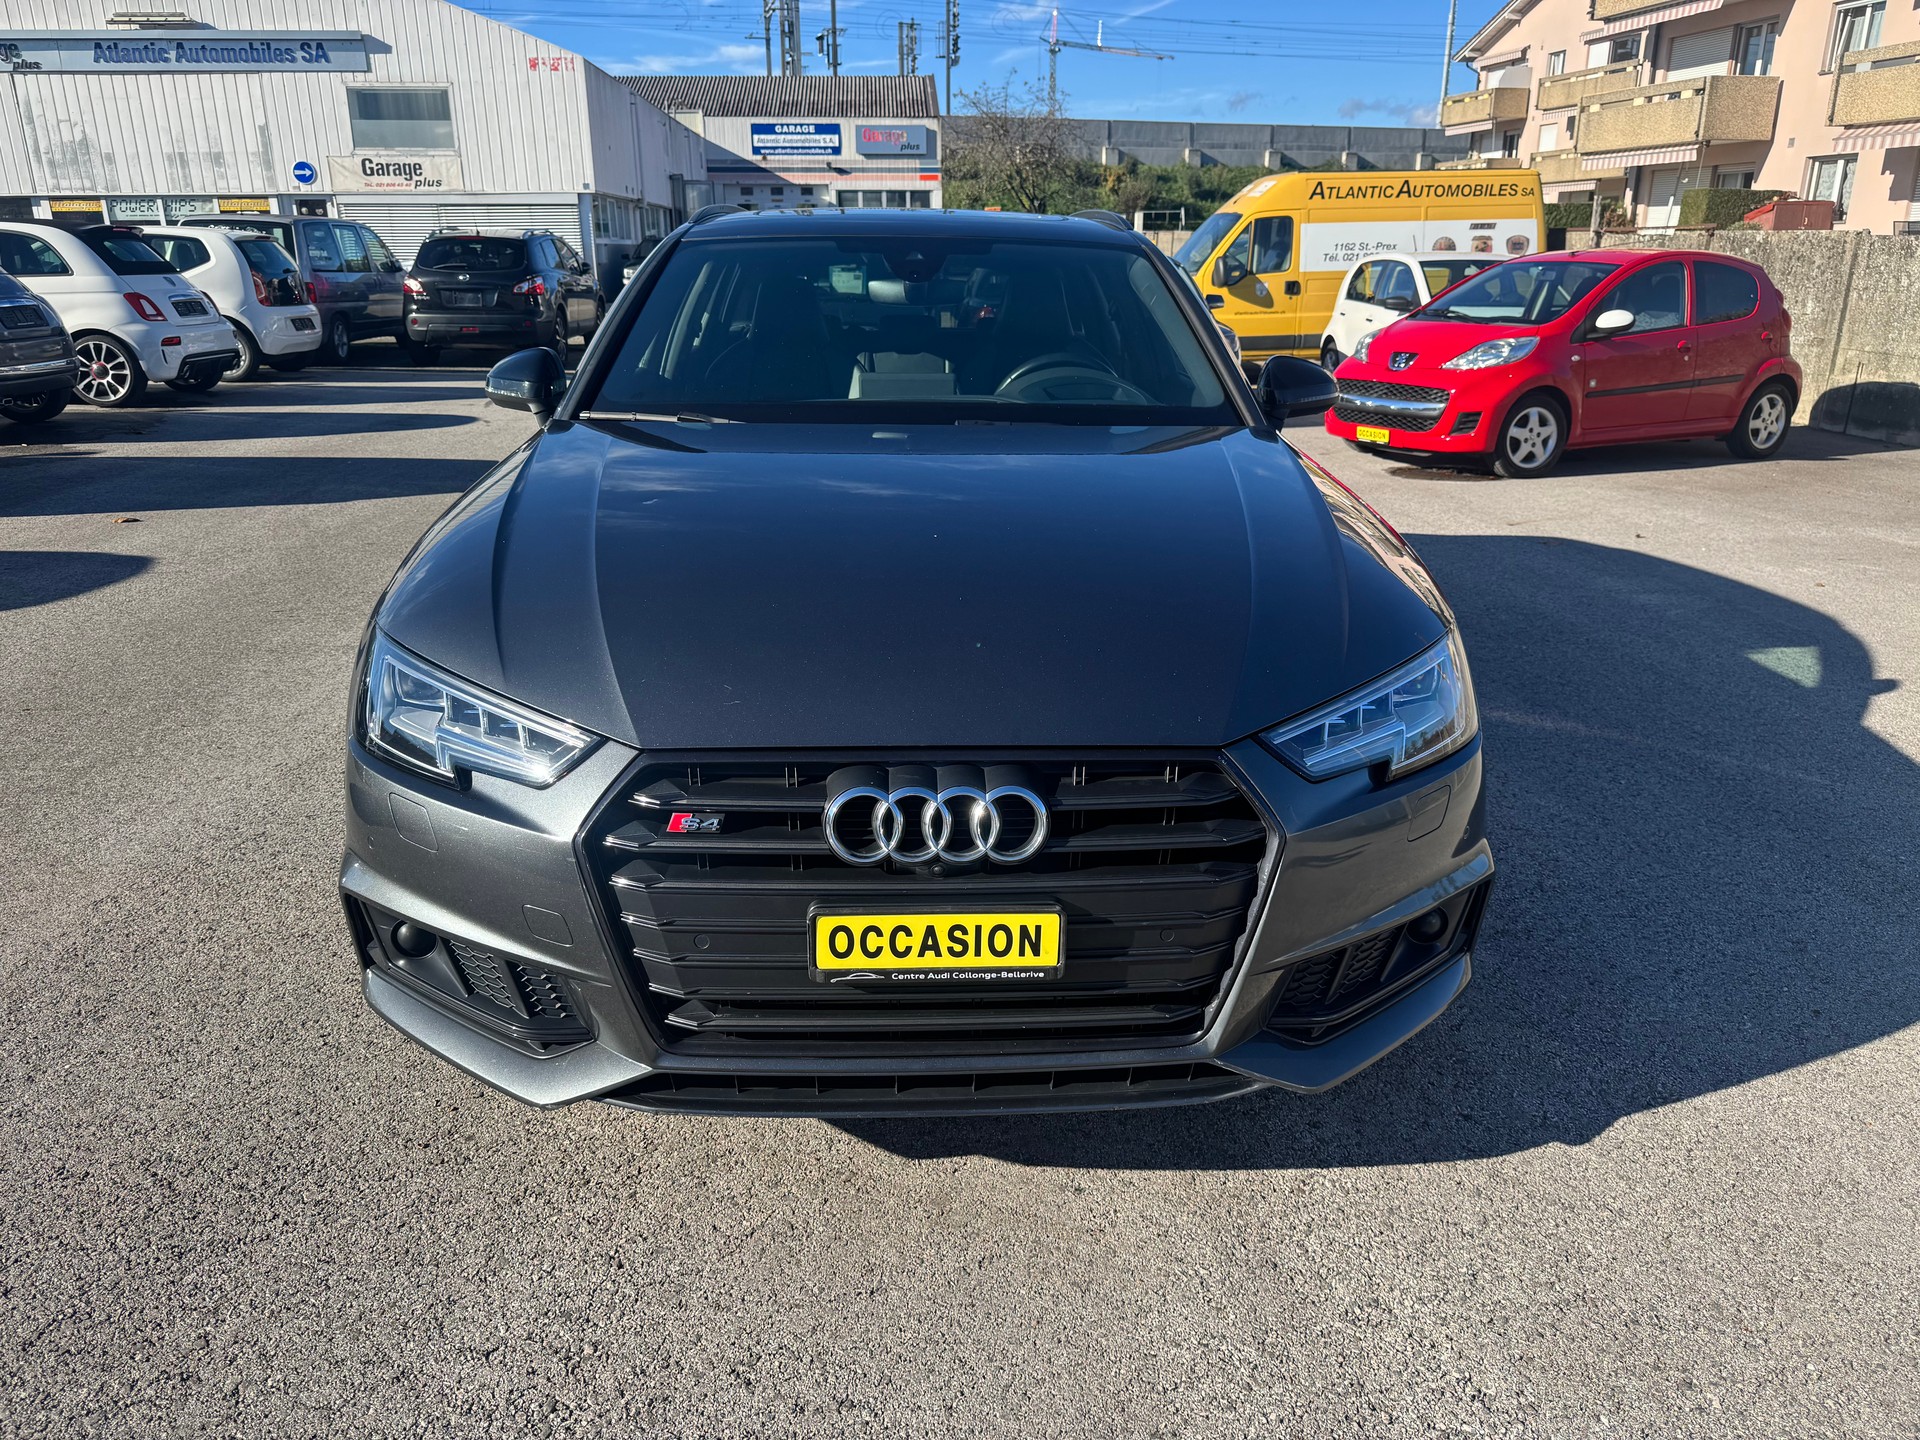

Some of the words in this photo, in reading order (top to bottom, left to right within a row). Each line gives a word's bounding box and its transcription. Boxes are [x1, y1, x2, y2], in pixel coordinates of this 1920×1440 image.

[93, 42, 170, 64] Atlantic
[175, 42, 297, 64] Automobiles
[300, 42, 331, 64] SA
[13, 59, 42, 71] plus
[775, 125, 815, 133] GARAGE
[863, 127, 908, 145] Garage
[900, 142, 920, 152] plus
[361, 158, 423, 181] Garage
[414, 177, 442, 189] plus
[1309, 181, 1395, 200] ATLANTIC
[1396, 180, 1519, 199] AUTOMOBILES
[1521, 187, 1535, 197] SA
[1334, 242, 1356, 252] 1162
[1358, 241, 1397, 252] St.-Prex
[1323, 253, 1340, 262] Tél.
[1343, 252, 1359, 261] 021
[1358, 429, 1386, 439] OCCASION
[679, 817, 720, 831] S4
[828, 924, 1042, 960] OCCASION
[891, 972, 926, 980] Centre
[927, 972, 951, 980] Audi
[952, 971, 1045, 980] Collonge-Bellerive
